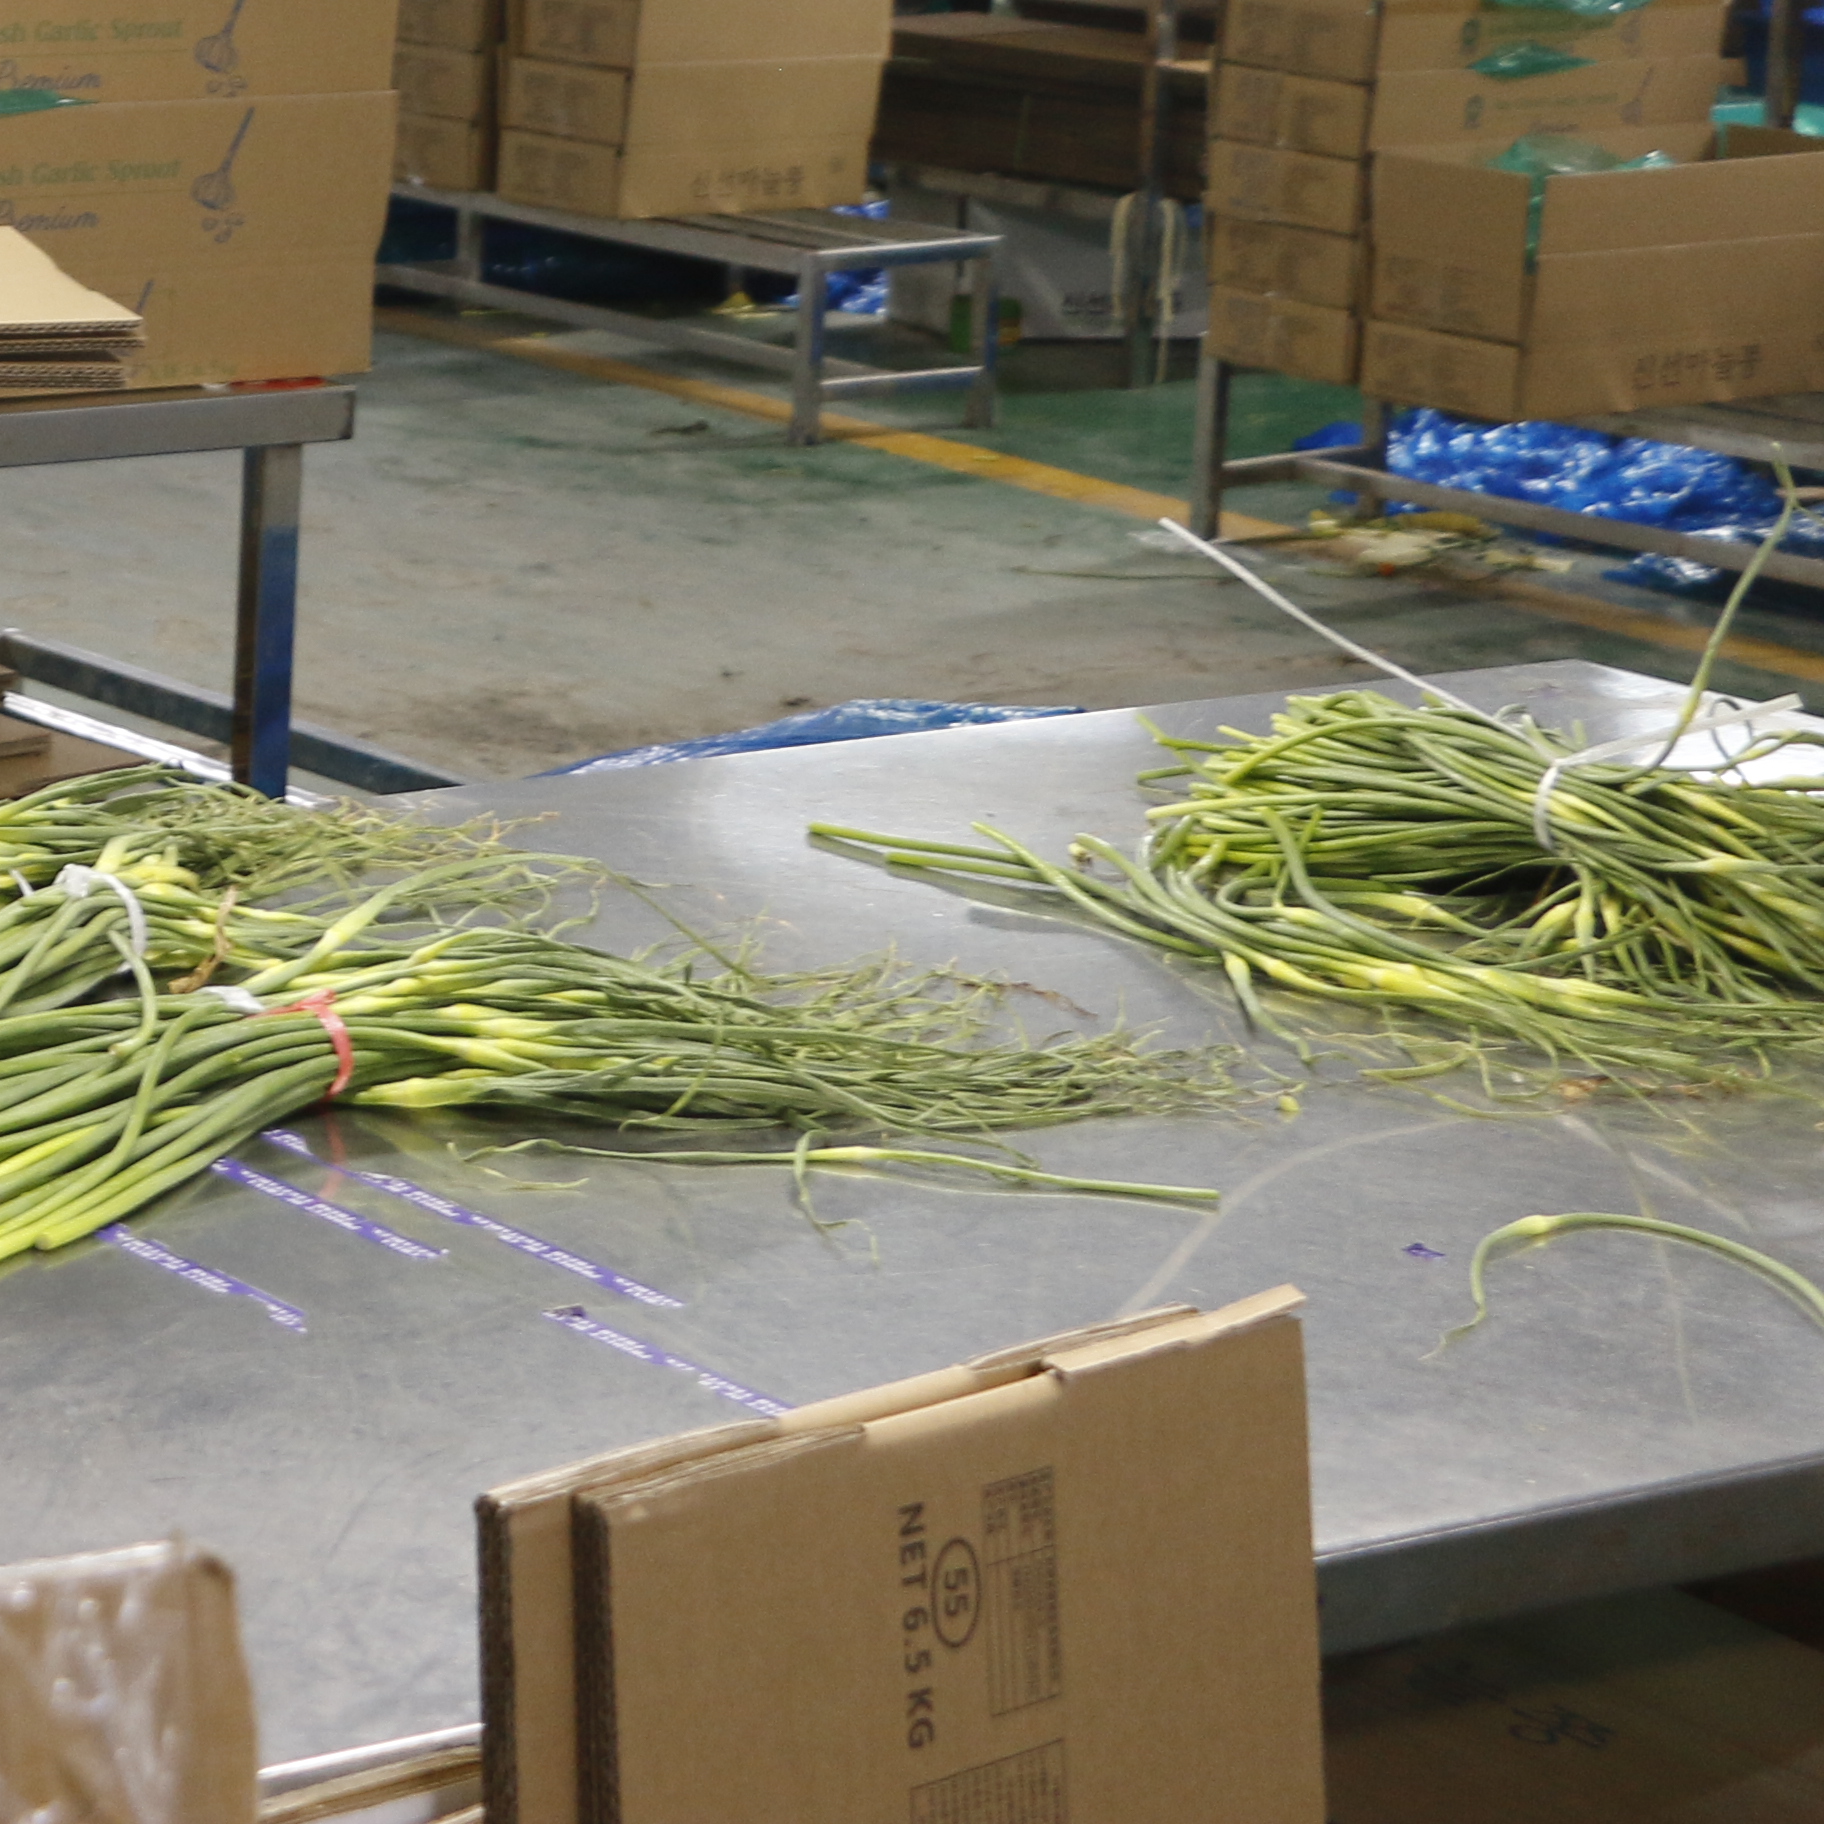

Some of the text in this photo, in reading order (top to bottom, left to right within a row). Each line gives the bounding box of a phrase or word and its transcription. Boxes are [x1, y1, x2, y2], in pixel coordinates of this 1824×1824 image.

[899, 1502, 936, 1750] NET 6.5 KG
